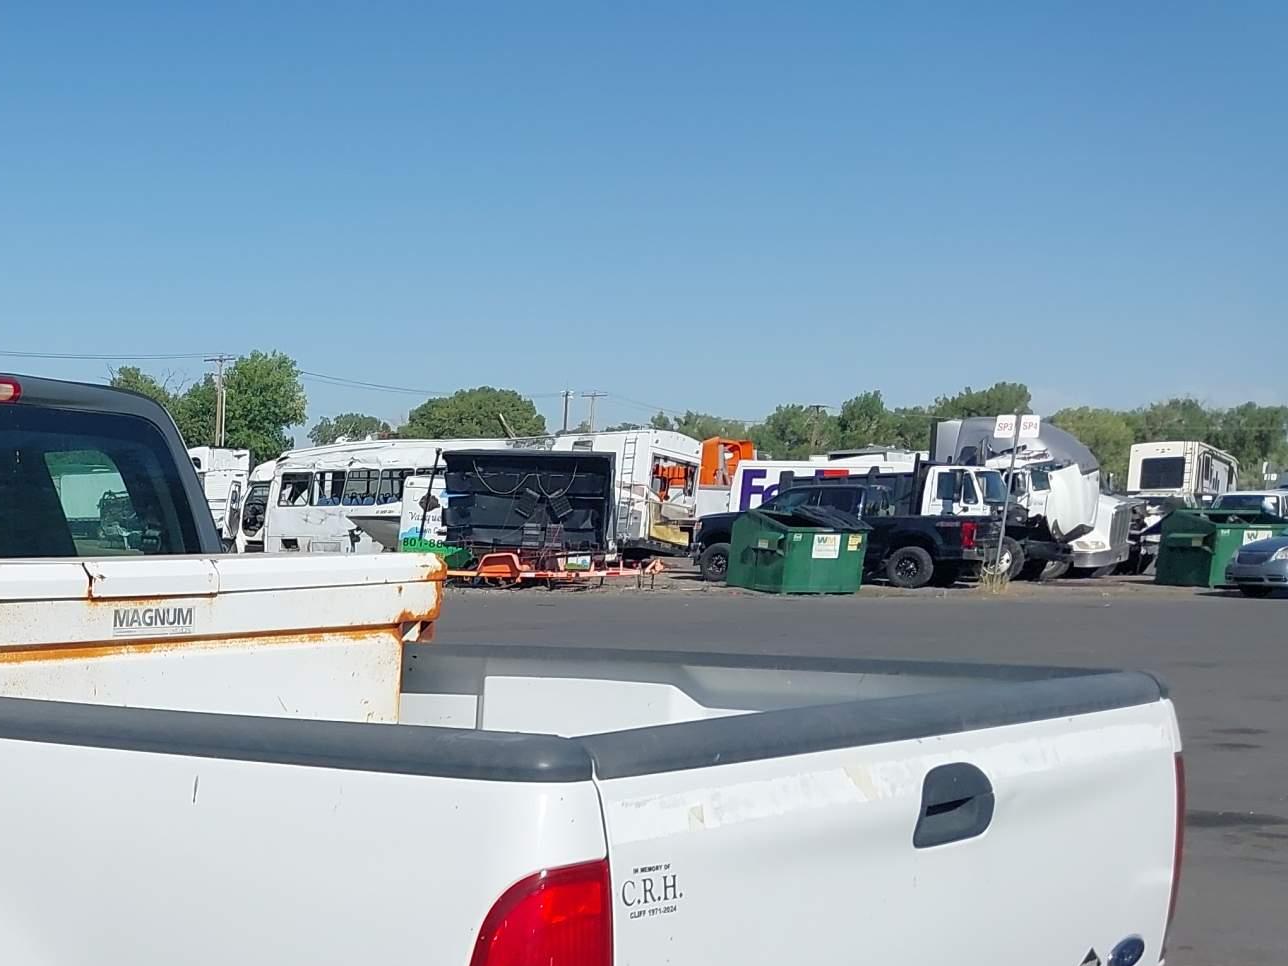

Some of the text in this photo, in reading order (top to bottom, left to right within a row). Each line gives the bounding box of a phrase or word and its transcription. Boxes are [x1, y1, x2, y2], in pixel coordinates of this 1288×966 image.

[997, 422, 1014, 432] SP3
[113, 607, 193, 628] MAGNUM
[640, 865, 662, 873] MEMORY
[621, 874, 684, 907] C.R.H.
[629, 909, 647, 919] CLIFF
